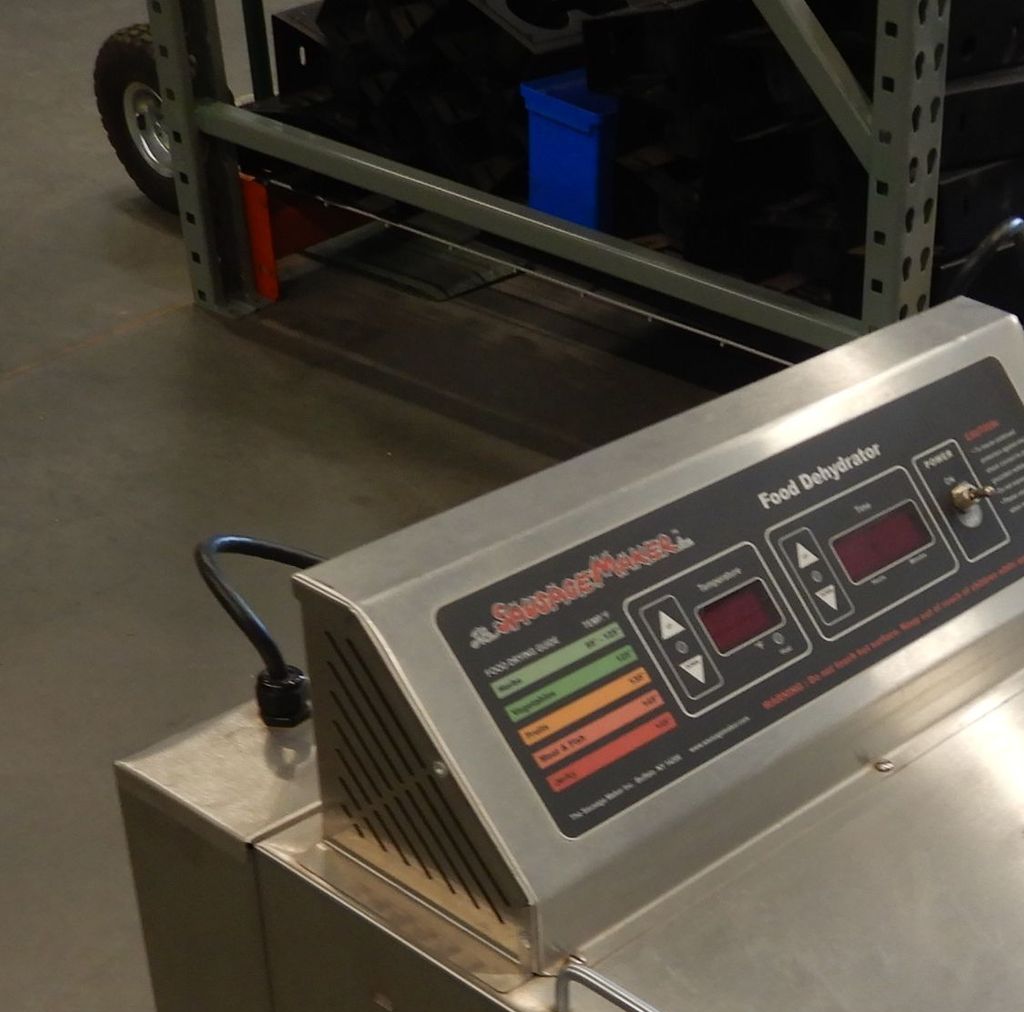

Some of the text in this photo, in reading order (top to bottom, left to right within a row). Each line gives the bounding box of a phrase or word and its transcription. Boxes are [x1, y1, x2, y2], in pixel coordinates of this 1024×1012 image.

[758, 444, 879, 508] Food Dehydrator
[923, 449, 952, 468] POWER
